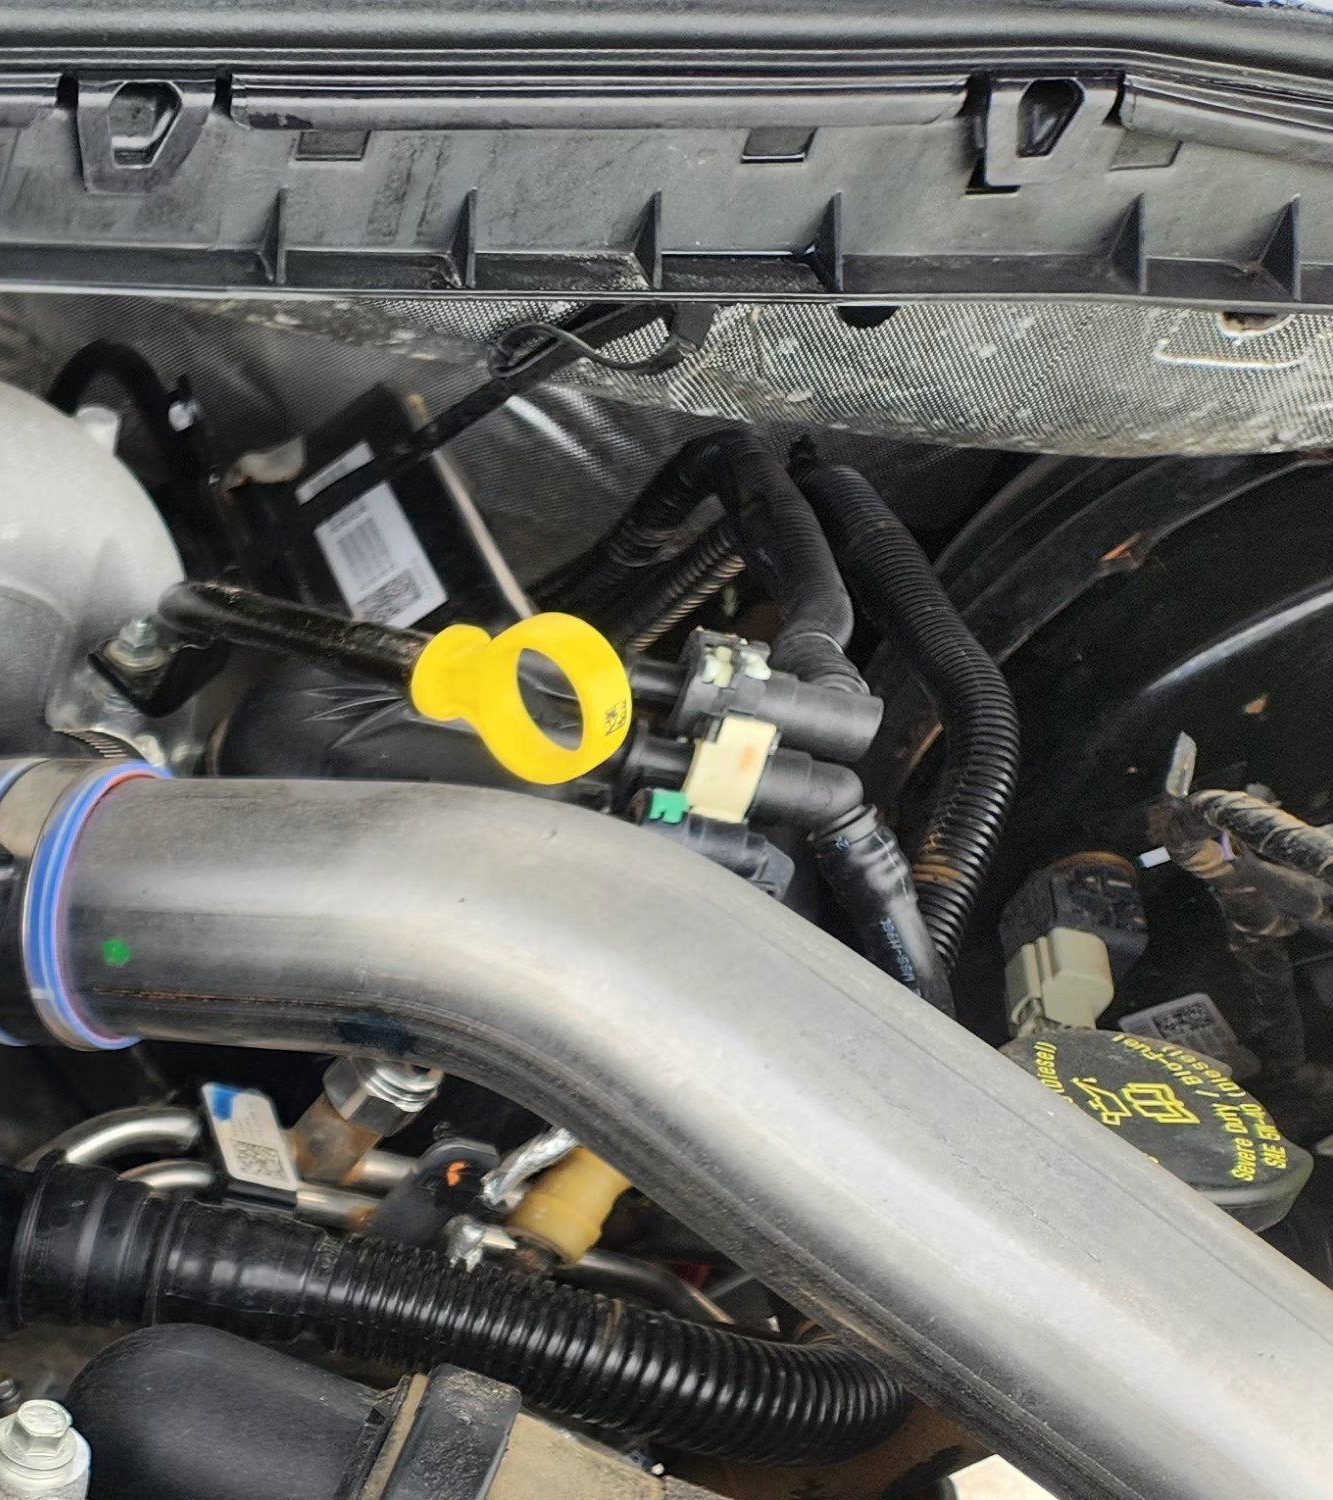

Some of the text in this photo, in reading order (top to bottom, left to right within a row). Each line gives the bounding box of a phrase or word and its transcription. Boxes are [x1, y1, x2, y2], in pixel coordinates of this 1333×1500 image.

[1110, 1033, 1204, 1086] Bio-Fuel
[1161, 1045, 1247, 1098] (Diesel)
[1231, 1137, 1256, 1182] Severe
[1261, 1142, 1287, 1170] SAE
